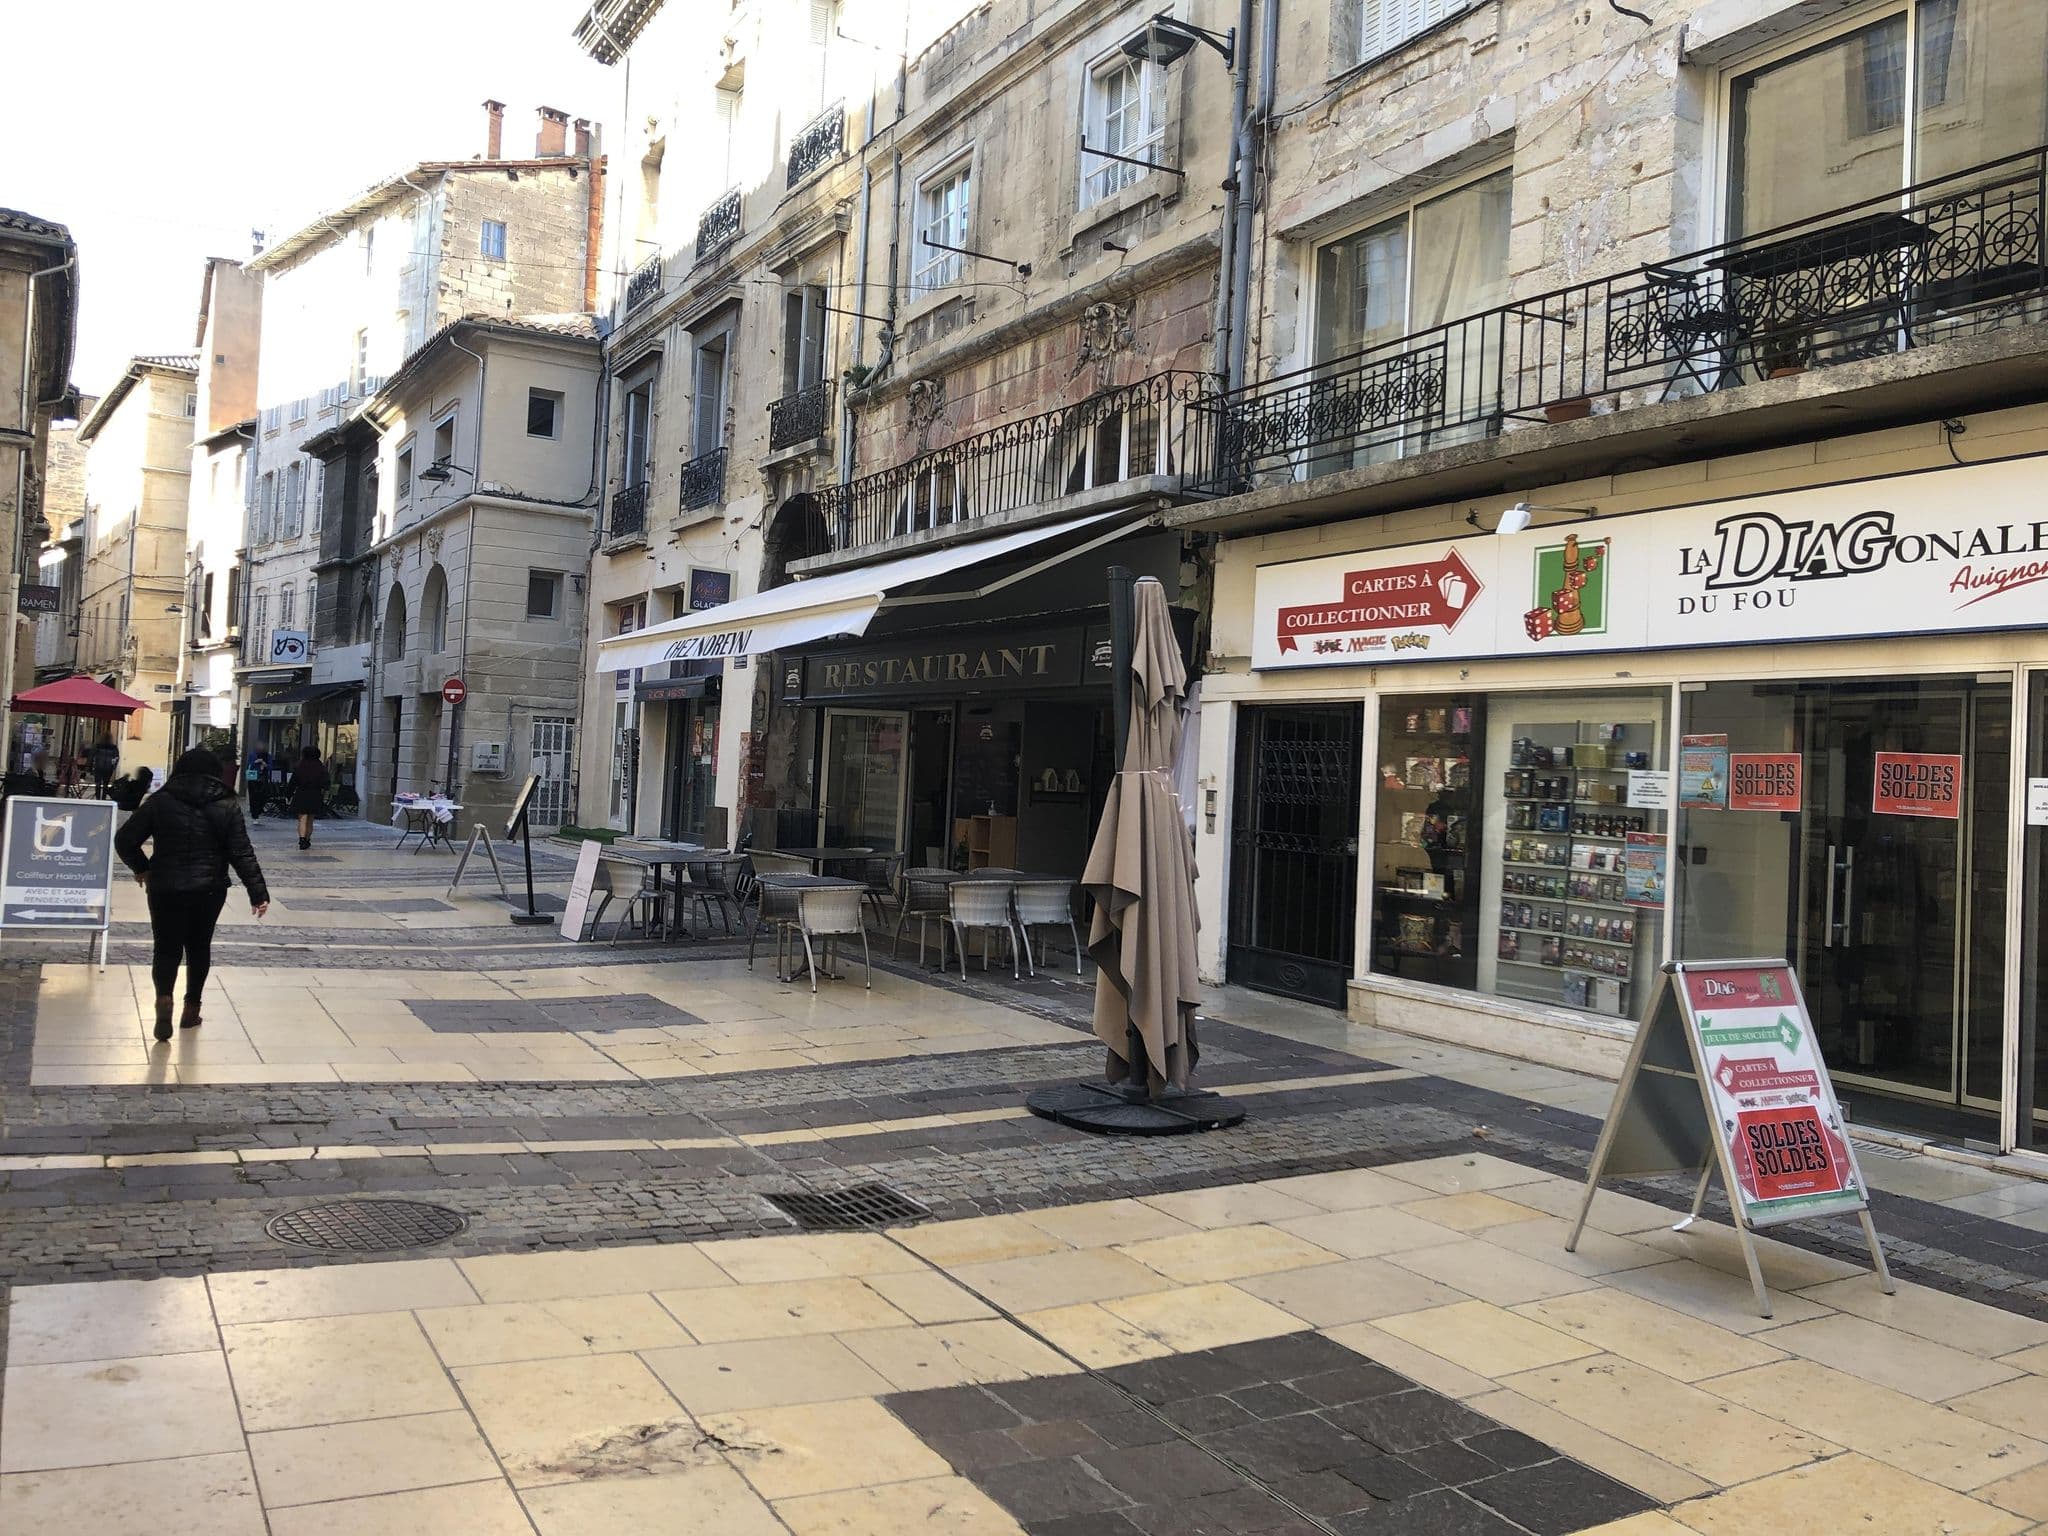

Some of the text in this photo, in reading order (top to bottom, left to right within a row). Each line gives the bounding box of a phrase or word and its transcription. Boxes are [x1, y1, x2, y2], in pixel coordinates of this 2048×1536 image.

[1351, 569, 1433, 595] CARTES À
[20, 598, 57, 609] RAMEN
[1678, 588, 1797, 615] DU FOU
[1286, 602, 1432, 628] COLLECTIONNER
[663, 630, 753, 660] CHEZ NOREYNI
[823, 644, 1056, 689] RESTAURANT
[1735, 763, 1796, 780] SOLDES
[1881, 763, 1954, 783] SOLDES
[1735, 780, 1796, 796] SOLDES
[1880, 780, 1953, 801] SOLDES
[16, 871, 97, 882] Coiffeur Hairstylist
[24, 896, 88, 904] RENDEZ-VOUS
[25, 888, 49, 896] AVEC
[51, 888, 62, 896] ET
[1705, 1034, 1727, 1044] JEUX
[1728, 1032, 1741, 1041] DE
[1735, 1063, 1767, 1073] CARTES
[1739, 1075, 1815, 1088] COLLECTIONNER
[1747, 1120, 1820, 1150] SOLDES
[1755, 1145, 1828, 1177] SOLDES
